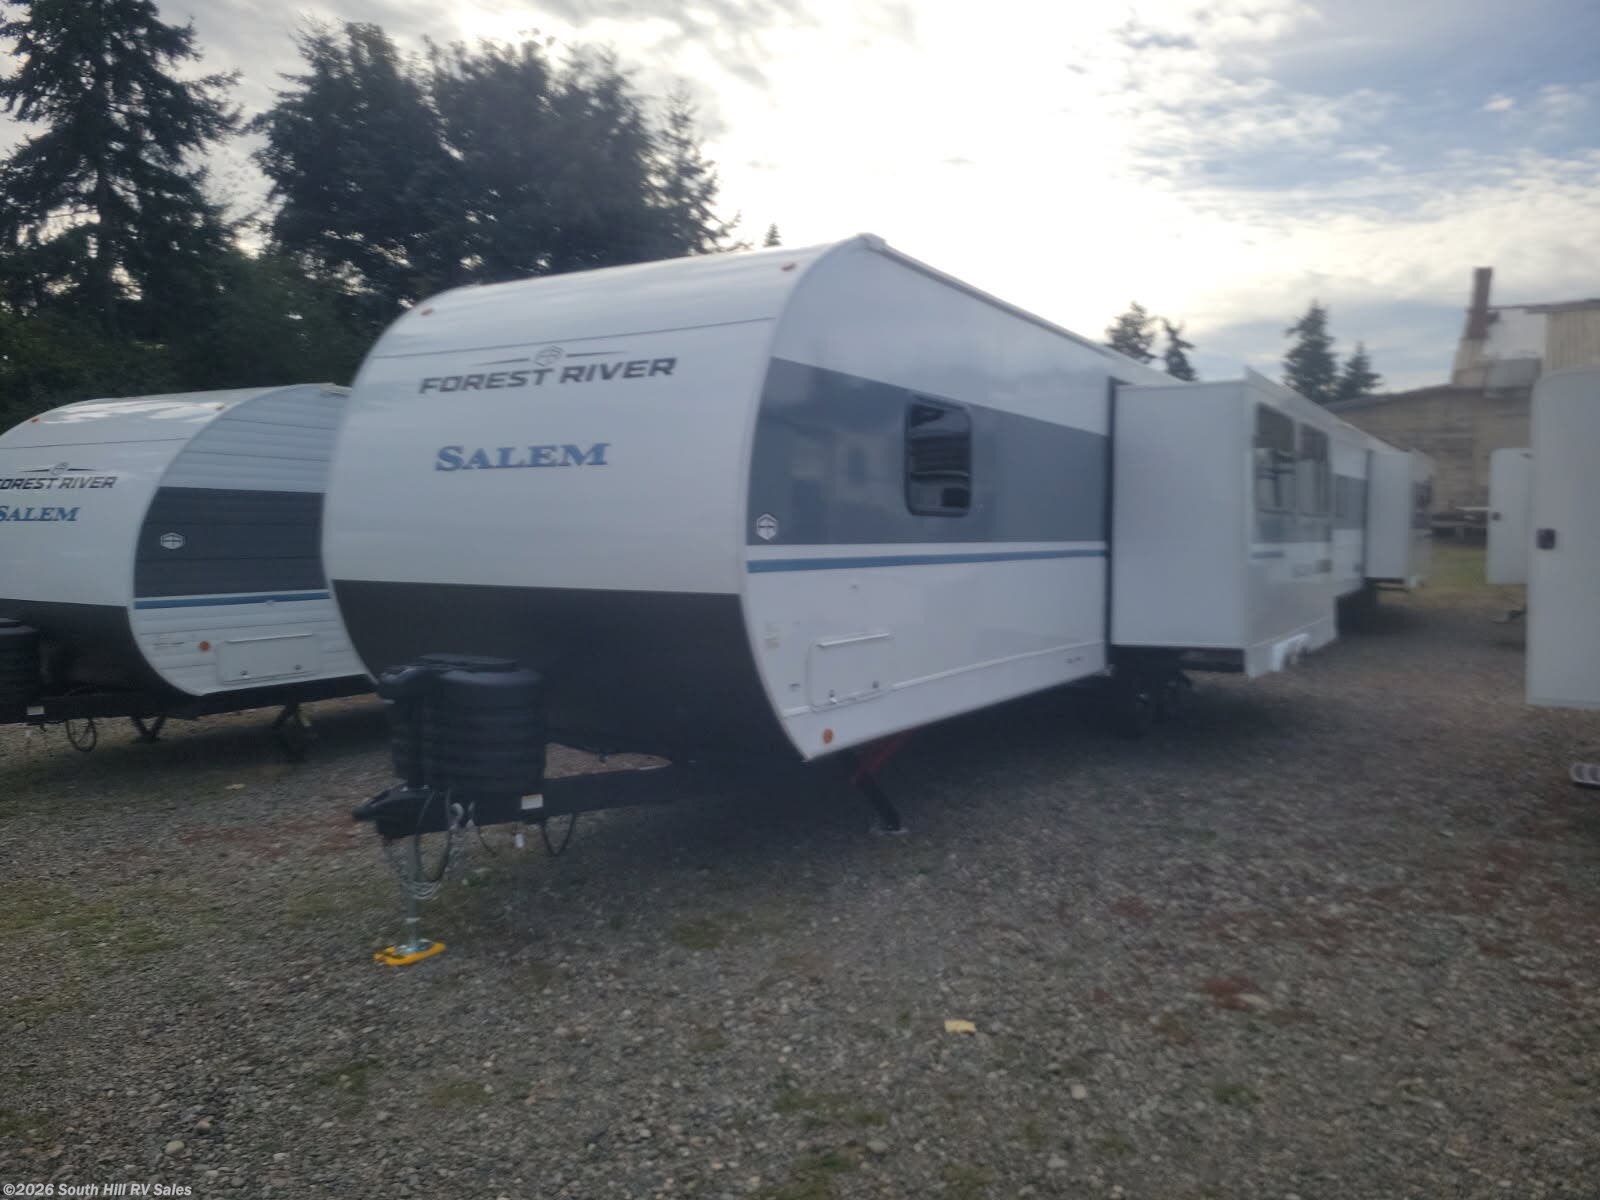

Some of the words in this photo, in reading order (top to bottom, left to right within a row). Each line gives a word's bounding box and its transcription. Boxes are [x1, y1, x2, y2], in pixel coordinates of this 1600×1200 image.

[419, 368, 552, 394] FOREST
[559, 357, 677, 384] RIVER
[435, 442, 610, 472] SALEM
[0, 477, 59, 490] OREST
[58, 476, 118, 489] RIVER
[0, 505, 80, 522] SALEM
